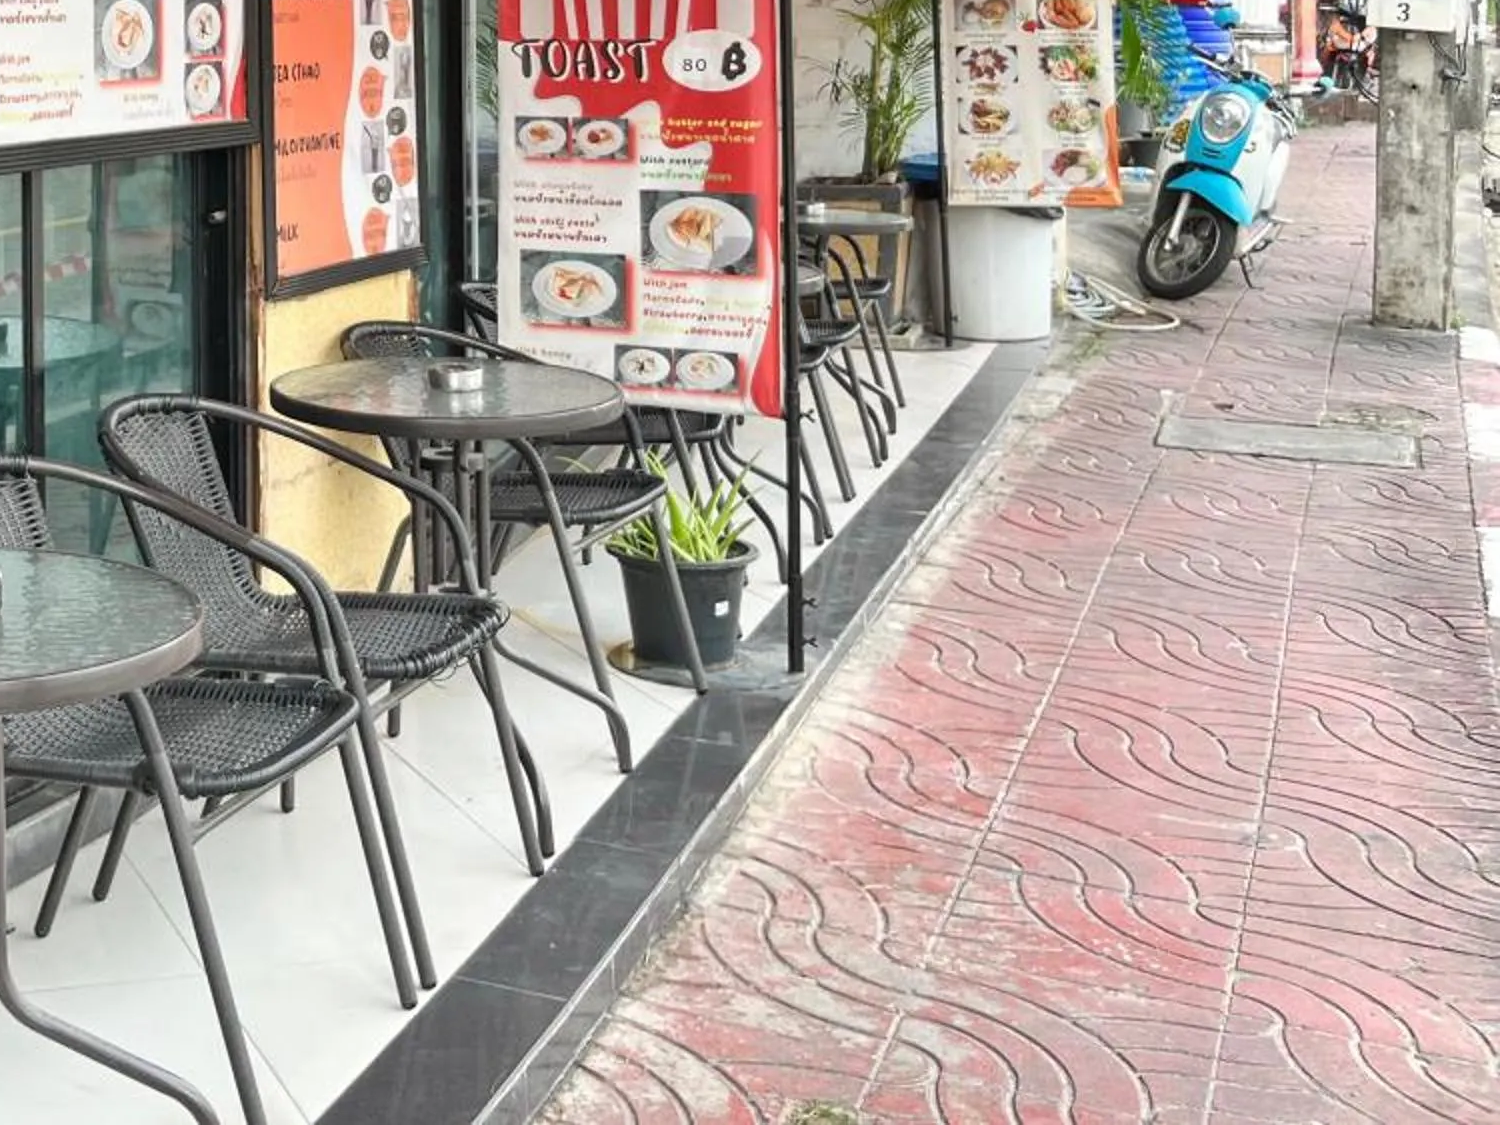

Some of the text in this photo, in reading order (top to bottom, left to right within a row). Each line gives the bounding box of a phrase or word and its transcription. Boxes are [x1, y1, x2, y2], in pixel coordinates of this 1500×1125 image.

[1396, 2, 1411, 22] 3
[511, 37, 658, 83] TOAST
[682, 58, 707, 72] 80
